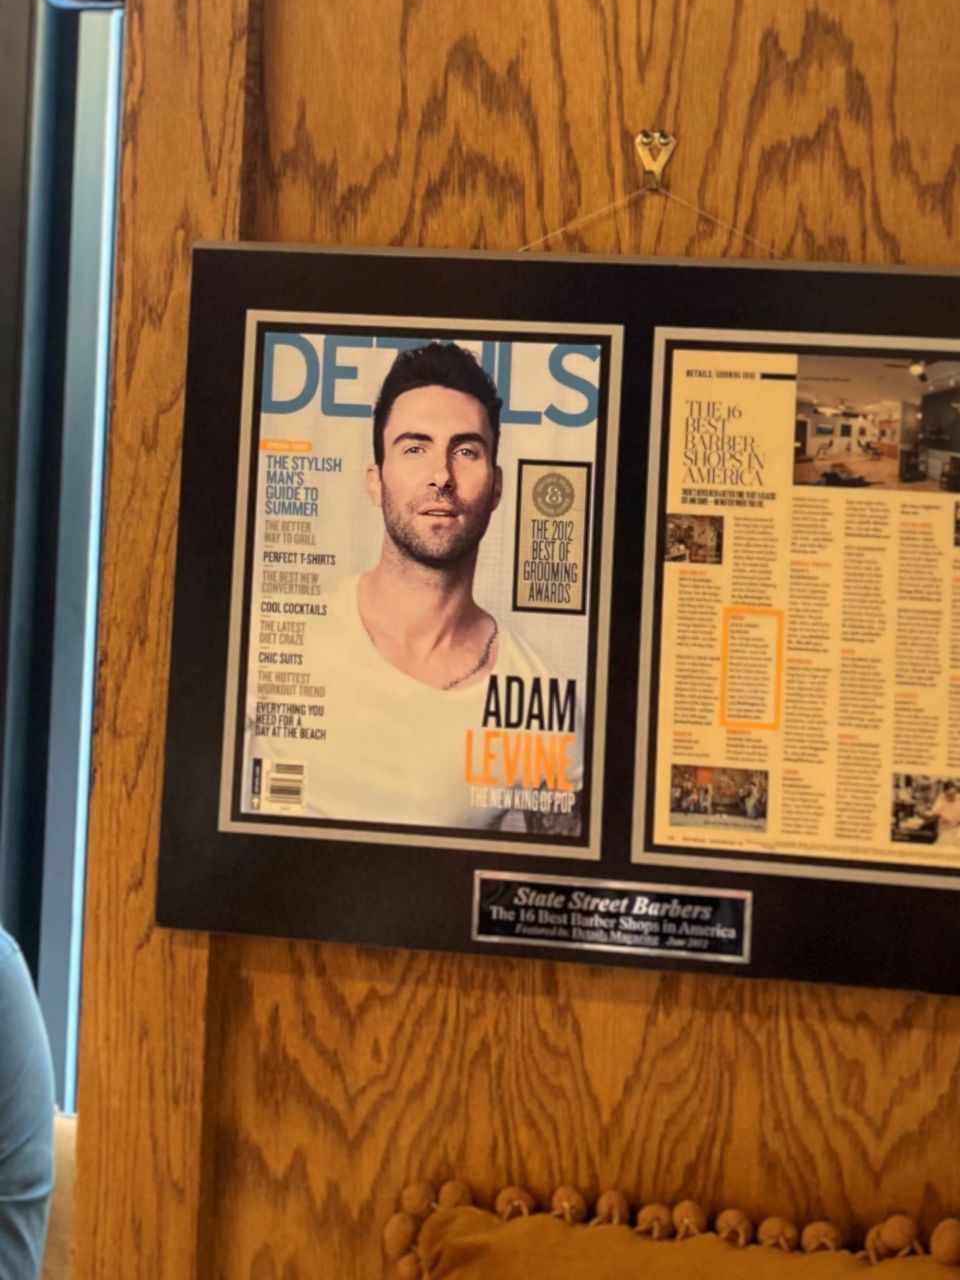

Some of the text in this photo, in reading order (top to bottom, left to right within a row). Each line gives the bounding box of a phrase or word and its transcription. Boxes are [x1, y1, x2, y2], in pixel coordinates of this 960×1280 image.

[261, 332, 601, 428] DEILS
[685, 400, 722, 420] THE
[685, 417, 726, 435] BEST
[266, 455, 342, 472] THE STYLISH
[683, 450, 765, 470] SHOPS IN
[266, 470, 304, 486] MAN'S
[682, 467, 764, 487] AMERICA
[265, 485, 319, 502] GUIDE TO
[265, 501, 318, 517] SUMMER
[264, 520, 311, 533] THE BETTER
[531, 519, 574, 541] THE 2012
[264, 532, 316, 546] WAY TO GRILL
[263, 551, 336, 566] PERFECT T-SHIRTS
[532, 540, 571, 562] BEST OF
[262, 570, 319, 584] THE BEST NEW
[523, 560, 578, 584] GROOMING
[262, 582, 321, 596] CONVERTIBLES
[528, 582, 571, 604] AWARDS
[261, 601, 328, 616] COOL COCKTAILS
[260, 620, 306, 633] THE LATEST
[279, 634, 304, 646] CRAZE
[258, 651, 304, 665] CHIC SUITS
[258, 671, 311, 684] THE HOTTEST
[257, 683, 326, 698] WORKOUT TREND
[256, 701, 325, 717] EVERYTHING YOU
[482, 674, 577, 733] ADAM
[255, 714, 302, 727] NEED FOR A
[255, 726, 327, 740] DAY AT THE BEACH
[464, 728, 577, 793] LEVINE
[470, 786, 576, 813] THE NEW KING OF POP
[513, 887, 713, 920] State Street Barbers
[489, 905, 737, 939] The 16 Best Barber Shops in America
